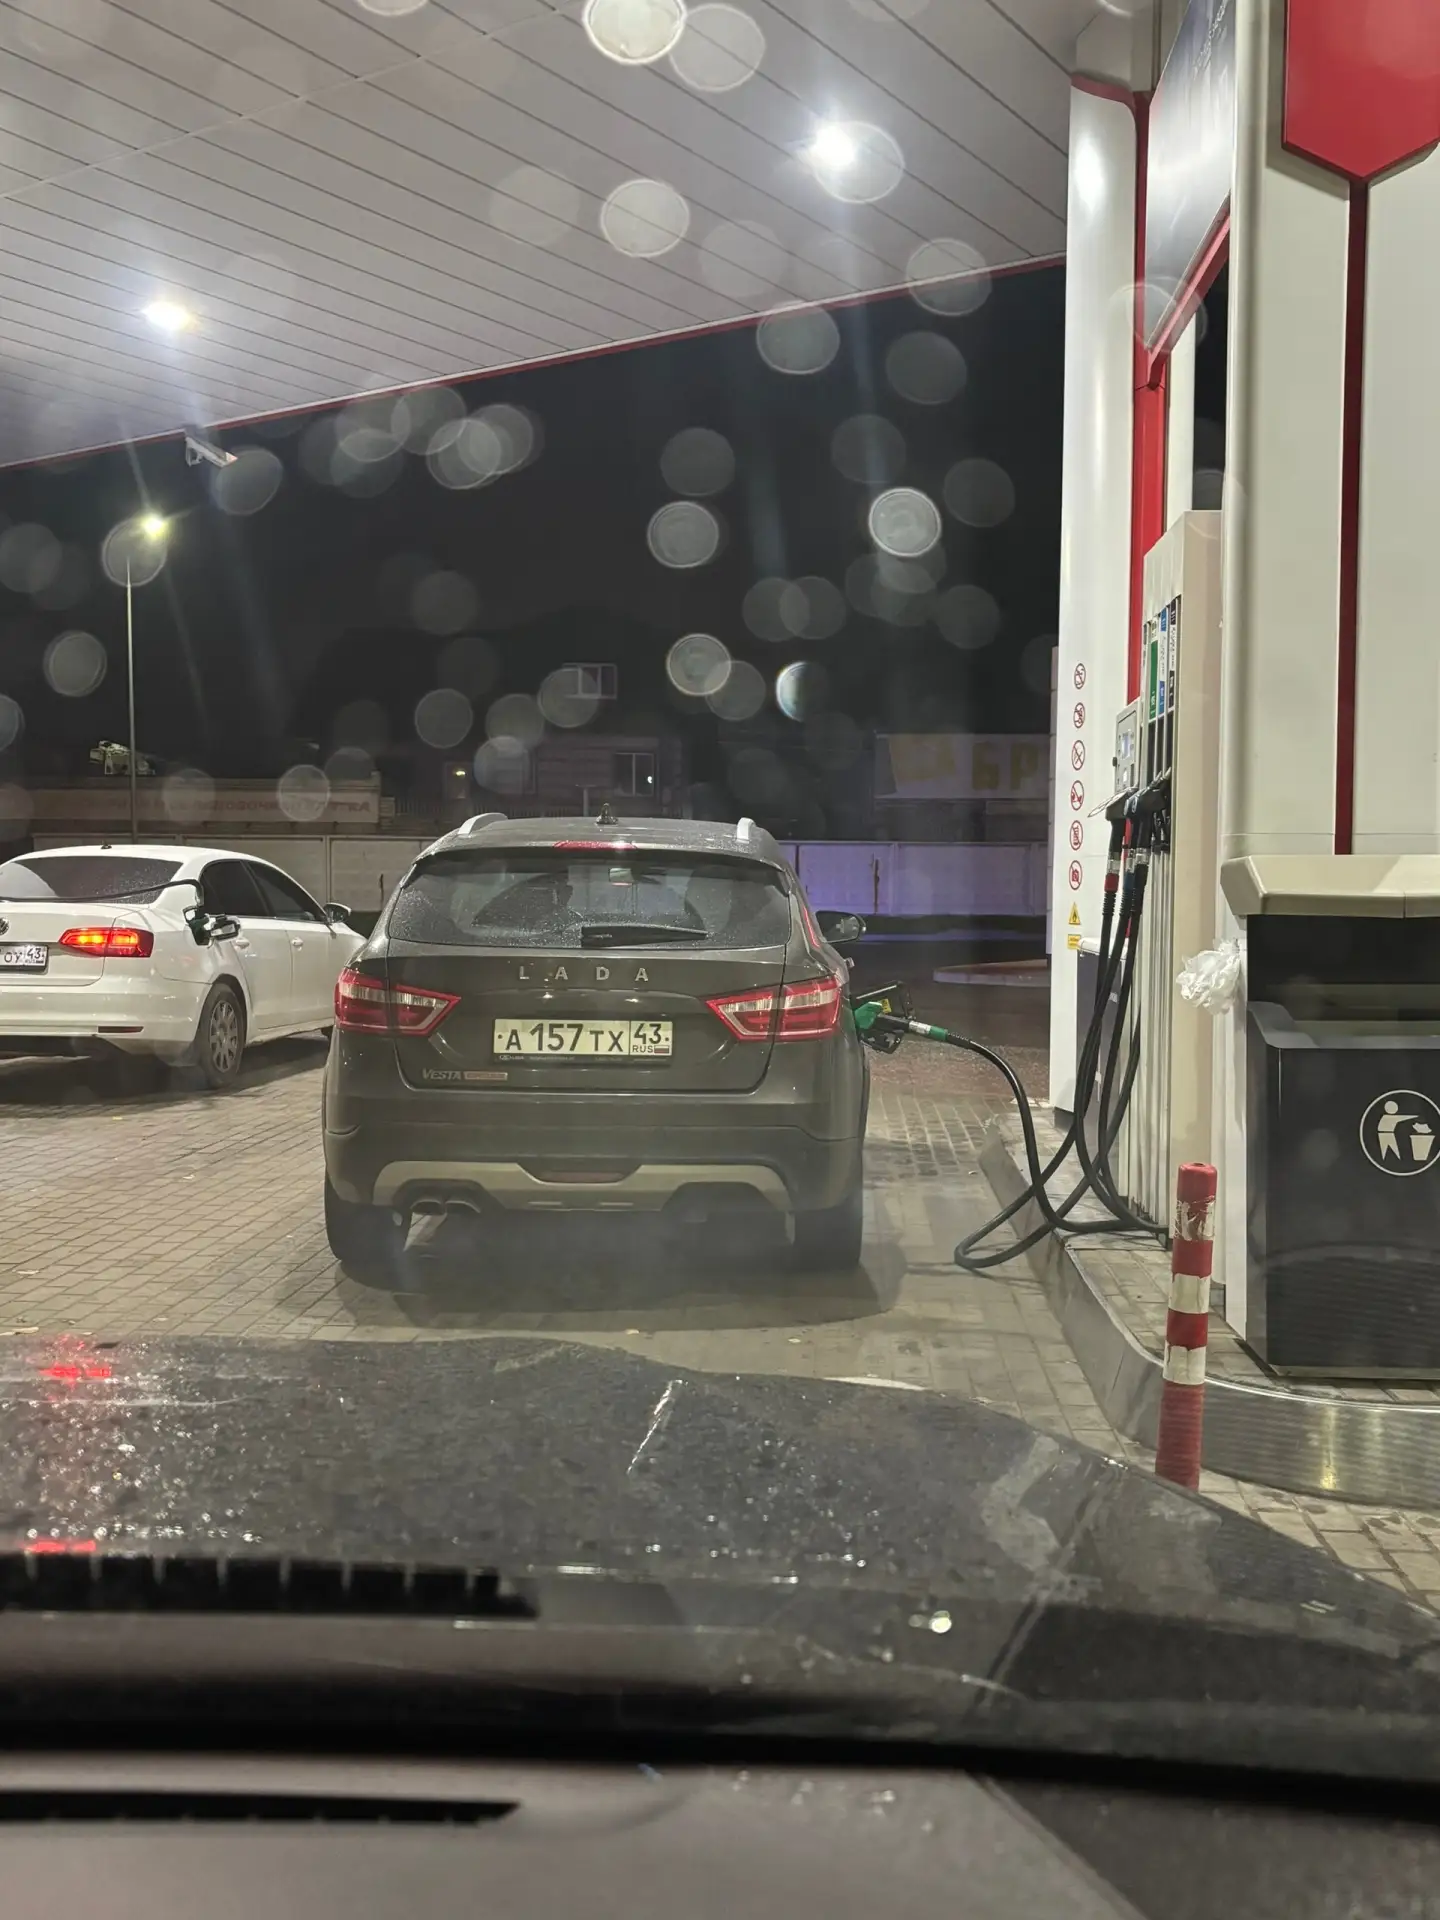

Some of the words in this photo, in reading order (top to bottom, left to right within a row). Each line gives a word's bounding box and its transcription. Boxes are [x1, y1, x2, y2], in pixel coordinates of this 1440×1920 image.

[27, 948, 41, 959] 43
[519, 966, 649, 981] LADA
[634, 1023, 662, 1045] 43
[632, 1045, 653, 1054] RUS
